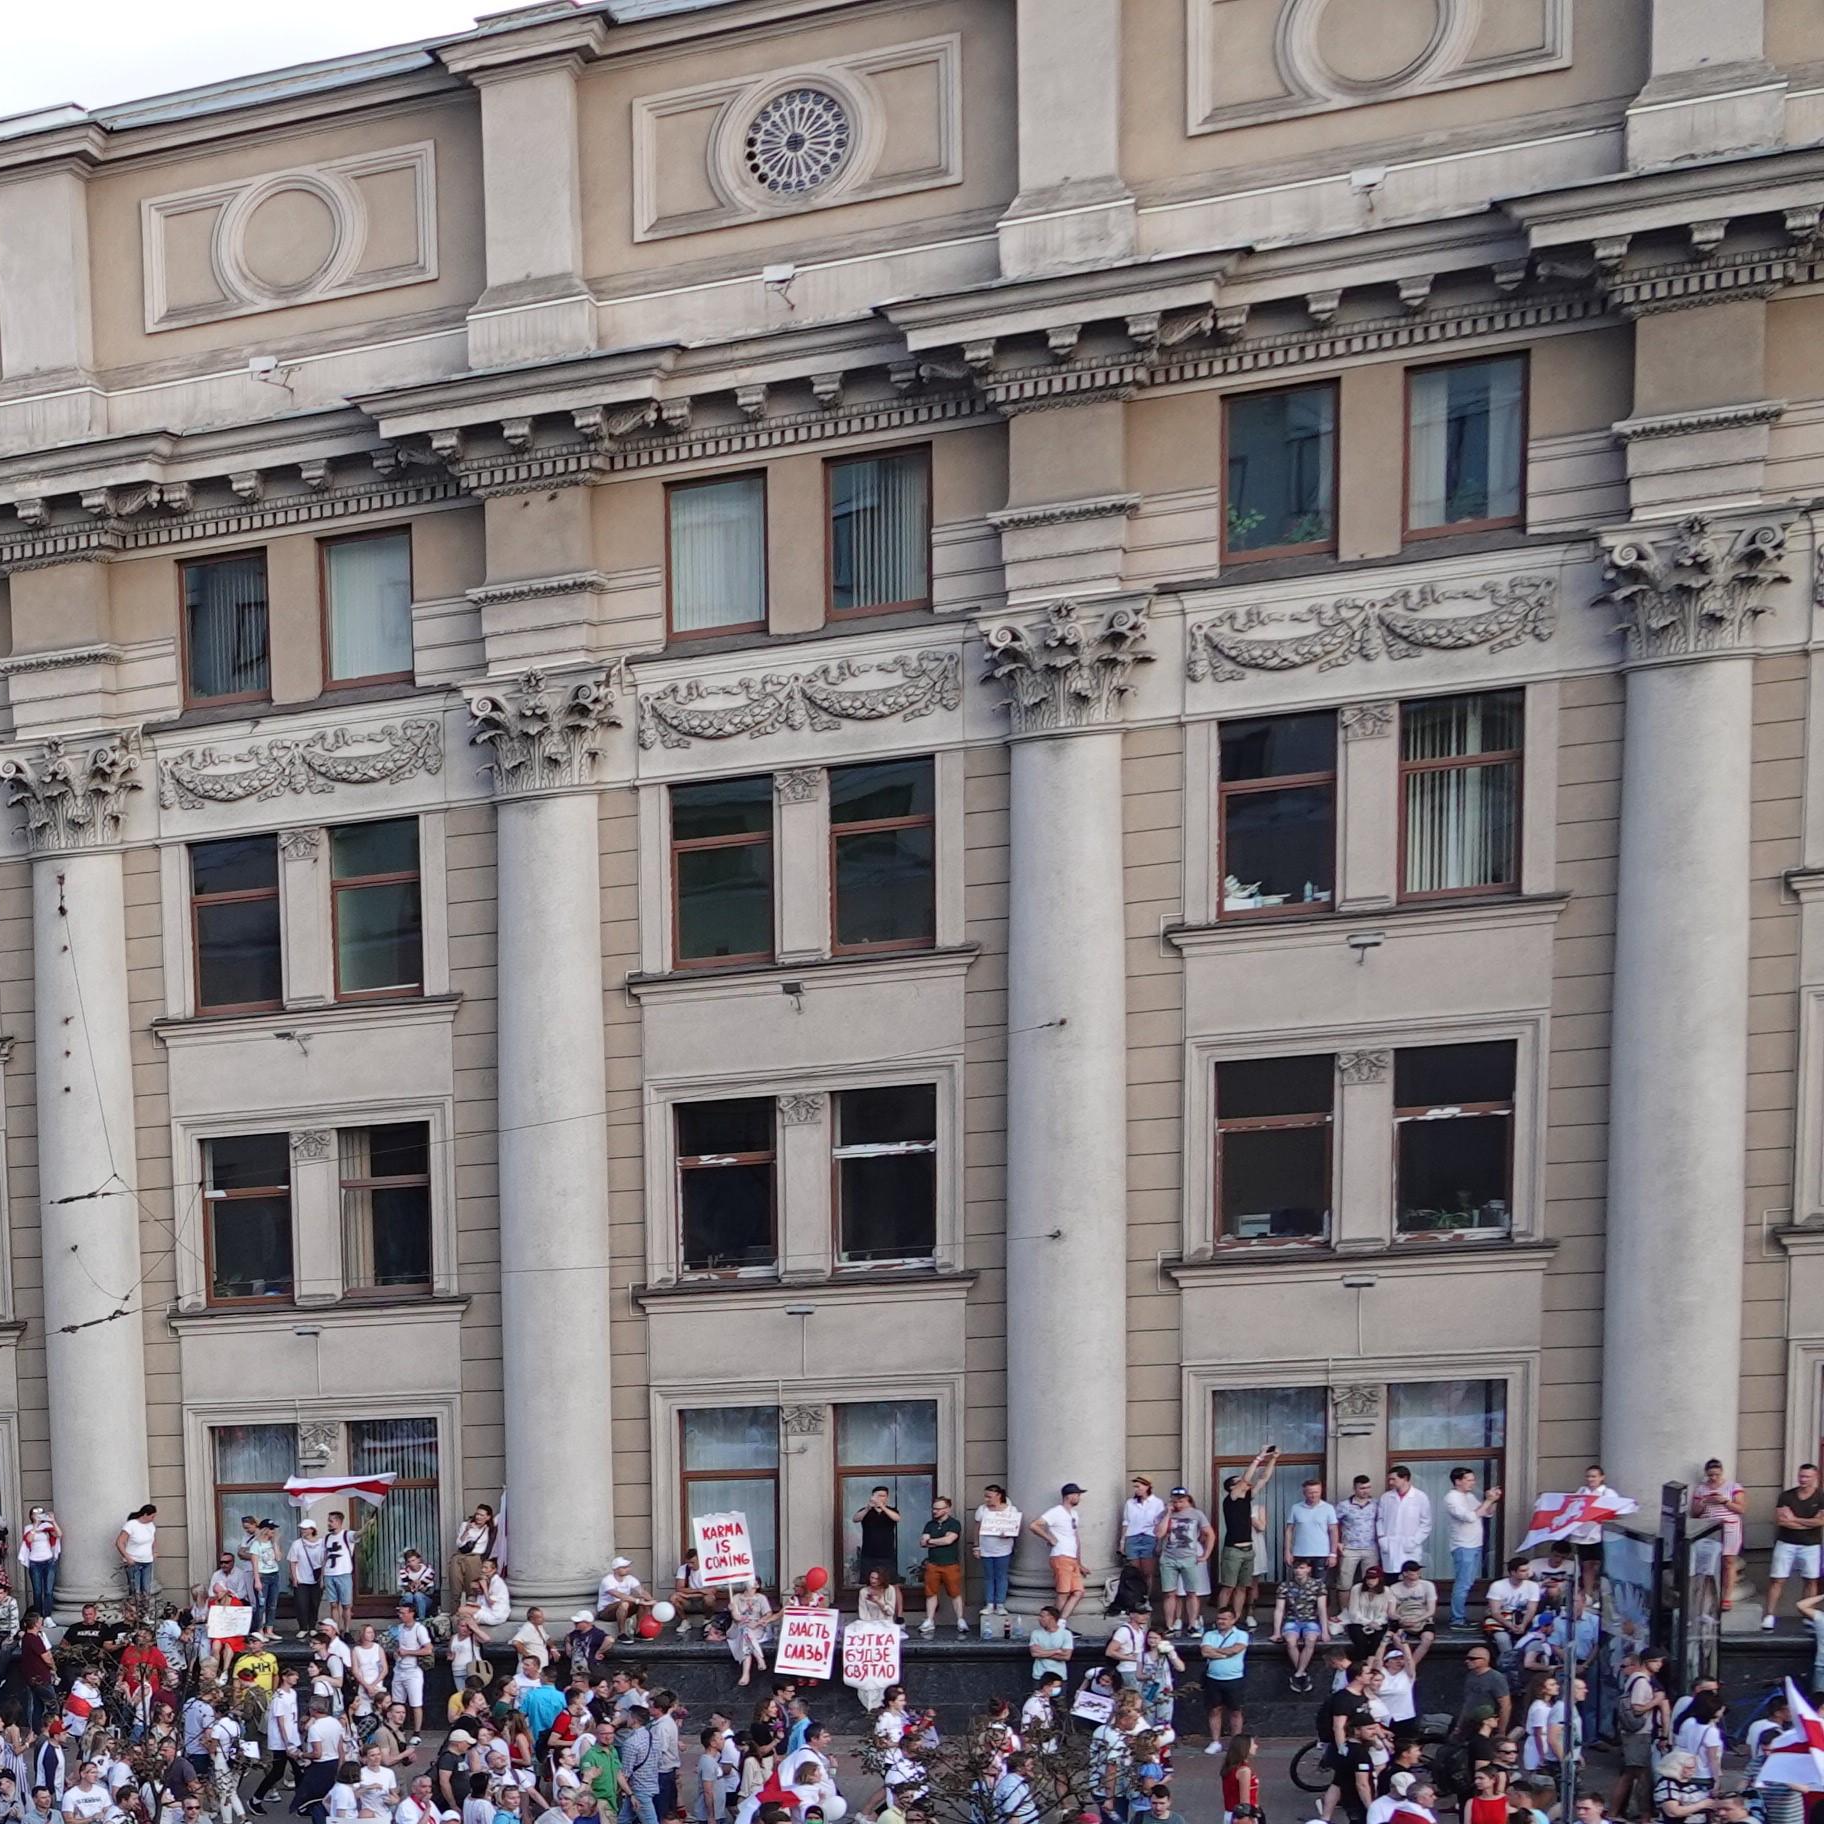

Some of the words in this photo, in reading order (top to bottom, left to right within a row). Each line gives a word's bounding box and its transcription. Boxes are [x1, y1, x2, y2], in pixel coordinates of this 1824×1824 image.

[702, 1522, 744, 1540] KARMA
[715, 1540, 731, 1555] IS
[705, 1552, 750, 1571] COMING
[788, 1622, 830, 1640] ВЛАСТЬ
[846, 1633, 895, 1647] ХУТКА
[784, 1641, 831, 1666] СЛАЗЬ!
[845, 1648, 891, 1664] БУДЗЕ
[844, 1663, 896, 1681] СВЯТЛО
